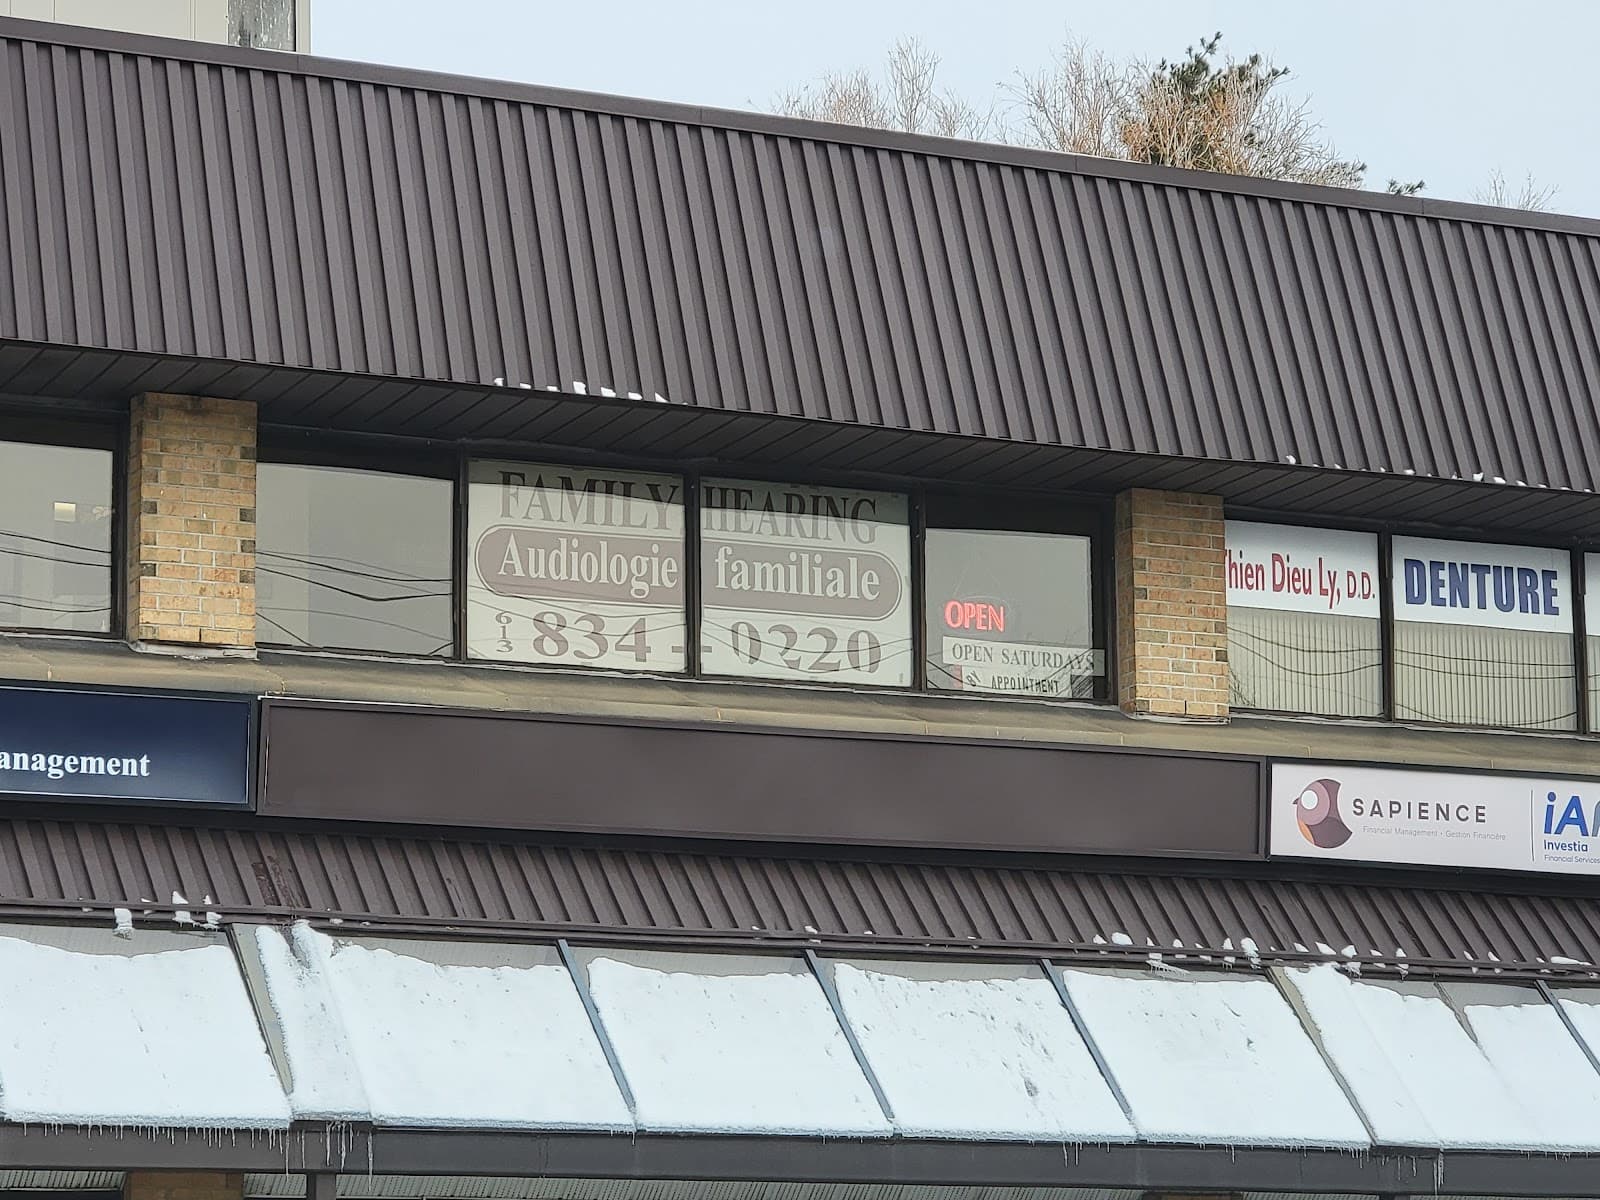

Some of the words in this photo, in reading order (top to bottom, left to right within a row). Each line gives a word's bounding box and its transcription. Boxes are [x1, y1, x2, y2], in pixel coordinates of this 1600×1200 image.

[500, 470, 680, 531] FAMILY
[703, 485, 879, 545] HEARING
[498, 532, 680, 599] Audiologie
[715, 545, 881, 601] familiale
[1225, 549, 1266, 591] hien
[1271, 553, 1312, 595] Dieu
[1318, 557, 1341, 609] Ly,
[1346, 570, 1376, 600] D.D.
[1404, 558, 1560, 617] DENTURE
[944, 600, 1006, 632] OPEN
[731, 621, 882, 674] 0220
[952, 642, 994, 663] OPEN
[1352, 798, 1487, 824] SAPIENCE
[1362, 825, 1393, 835] Financial
[1394, 827, 1439, 838] Management
[1445, 830, 1471, 840] Gestion
[1543, 839, 1588, 853] Investia
[1544, 854, 1574, 863] Financial
